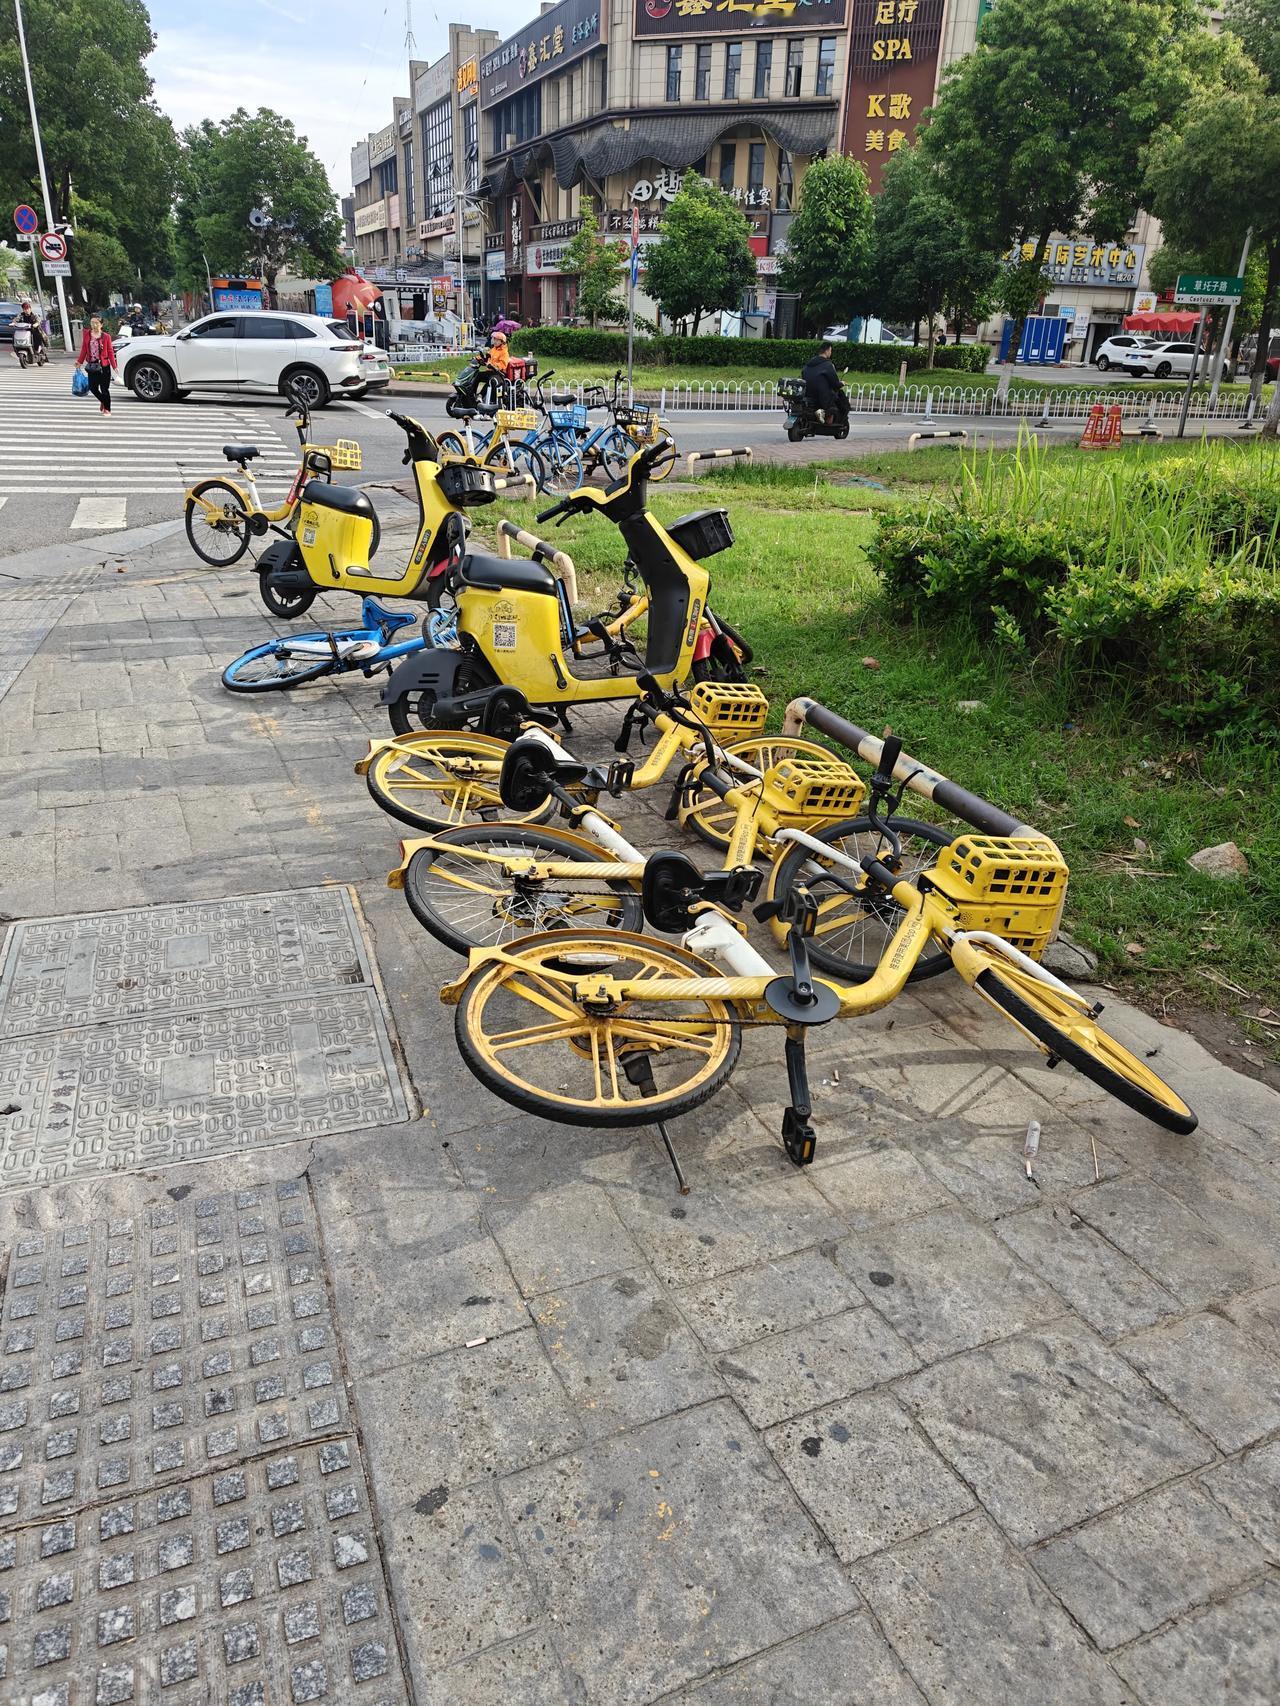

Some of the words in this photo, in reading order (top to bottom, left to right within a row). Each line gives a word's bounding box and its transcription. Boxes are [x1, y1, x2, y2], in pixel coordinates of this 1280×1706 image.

[875, 0, 919, 25] 足疗
[872, 38, 912, 61] SPA
[866, 93, 912, 120] K歌
[865, 128, 906, 152] 美食
